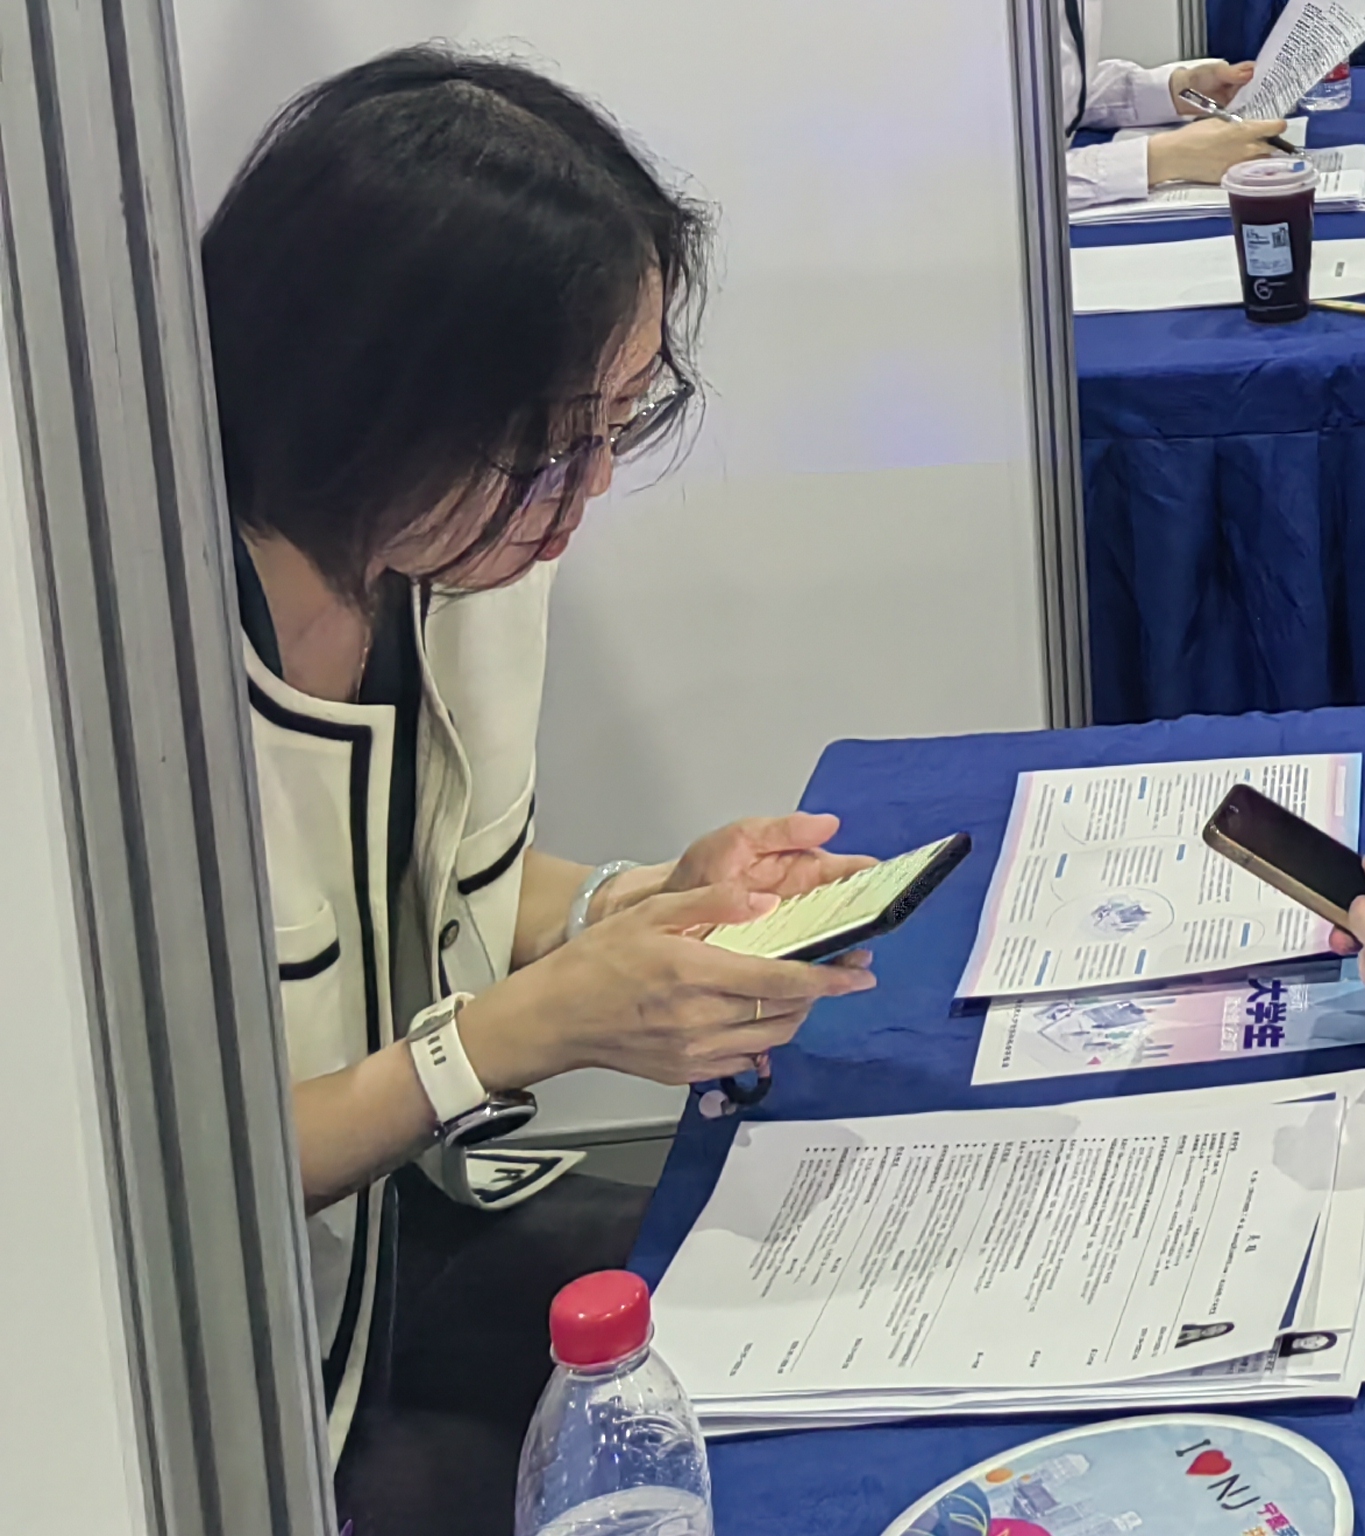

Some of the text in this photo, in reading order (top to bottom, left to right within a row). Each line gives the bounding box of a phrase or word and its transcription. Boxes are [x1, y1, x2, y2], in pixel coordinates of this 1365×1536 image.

[1243, 978, 1288, 1051] 大学生
[1175, 1438, 1211, 1457] I
[1206, 1473, 1261, 1510] NJ
